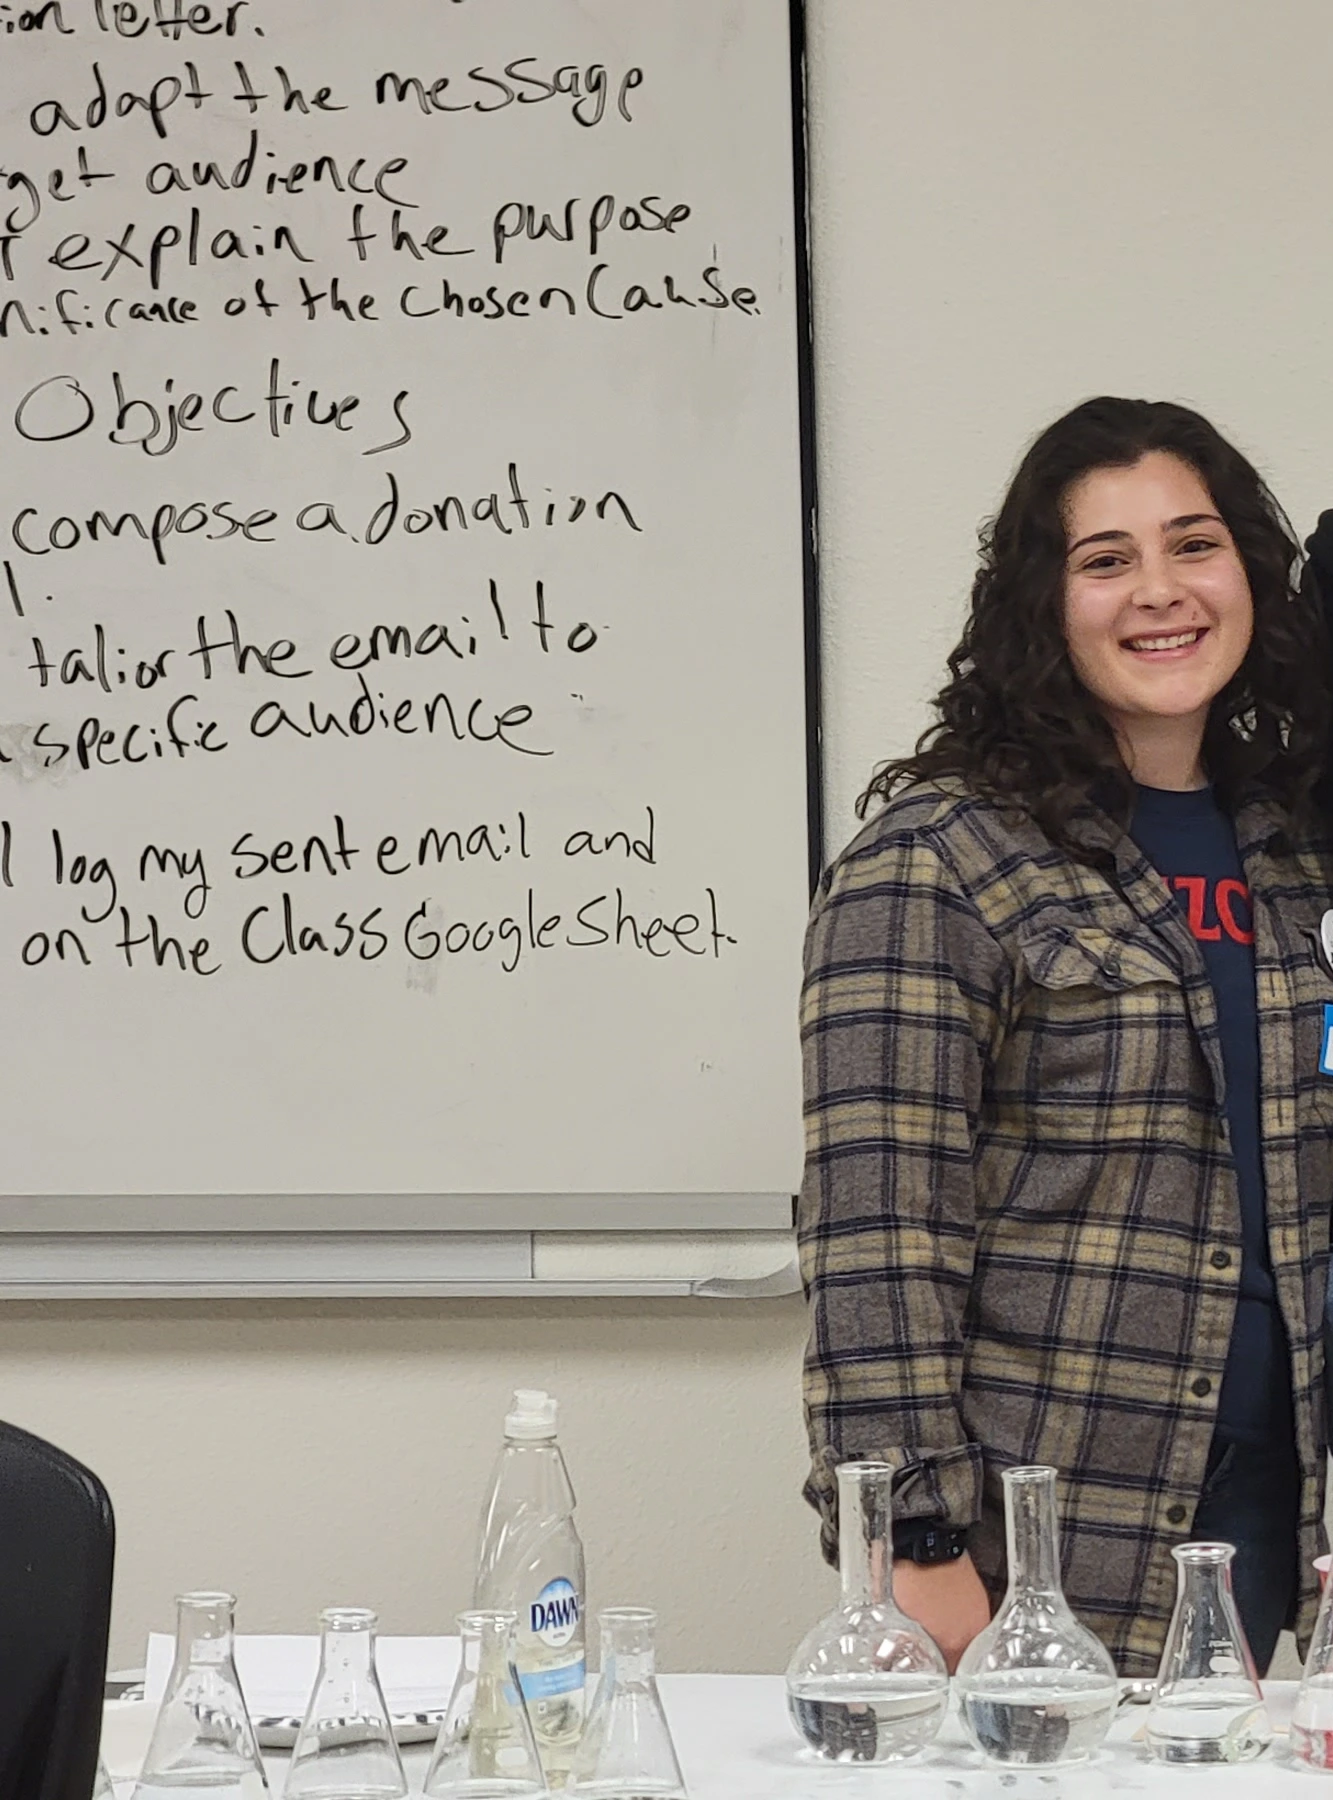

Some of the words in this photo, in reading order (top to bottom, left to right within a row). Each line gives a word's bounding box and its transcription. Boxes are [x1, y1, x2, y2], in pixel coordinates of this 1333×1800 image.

[0, 0, 76, 35] ion
[29, 60, 214, 140] adapt
[232, 60, 349, 115] the
[375, 57, 644, 128] message
[0, 145, 116, 234] get
[145, 128, 420, 209] audience
[47, 206, 315, 291] explain
[347, 203, 476, 262] the
[493, 194, 692, 263] purpose
[223, 277, 280, 318] of
[298, 276, 380, 322] the
[14, 357, 412, 457] Objectives
[11, 501, 278, 566] compose
[365, 461, 643, 545] donation
[187, 609, 314, 680] the
[329, 577, 510, 671] email
[531, 579, 598, 654] to
[32, 694, 229, 771] specific
[249, 671, 555, 757] audience
[51, 828, 118, 924] log
[139, 844, 213, 920] my
[230, 814, 361, 880] sent
[376, 811, 531, 876] email
[563, 805, 657, 865] and
[21, 928, 92, 966] on
[115, 905, 223, 976] the
[241, 891, 388, 965] Class
[404, 887, 561, 973] Google
[531, 1595, 578, 1633] DAWN
